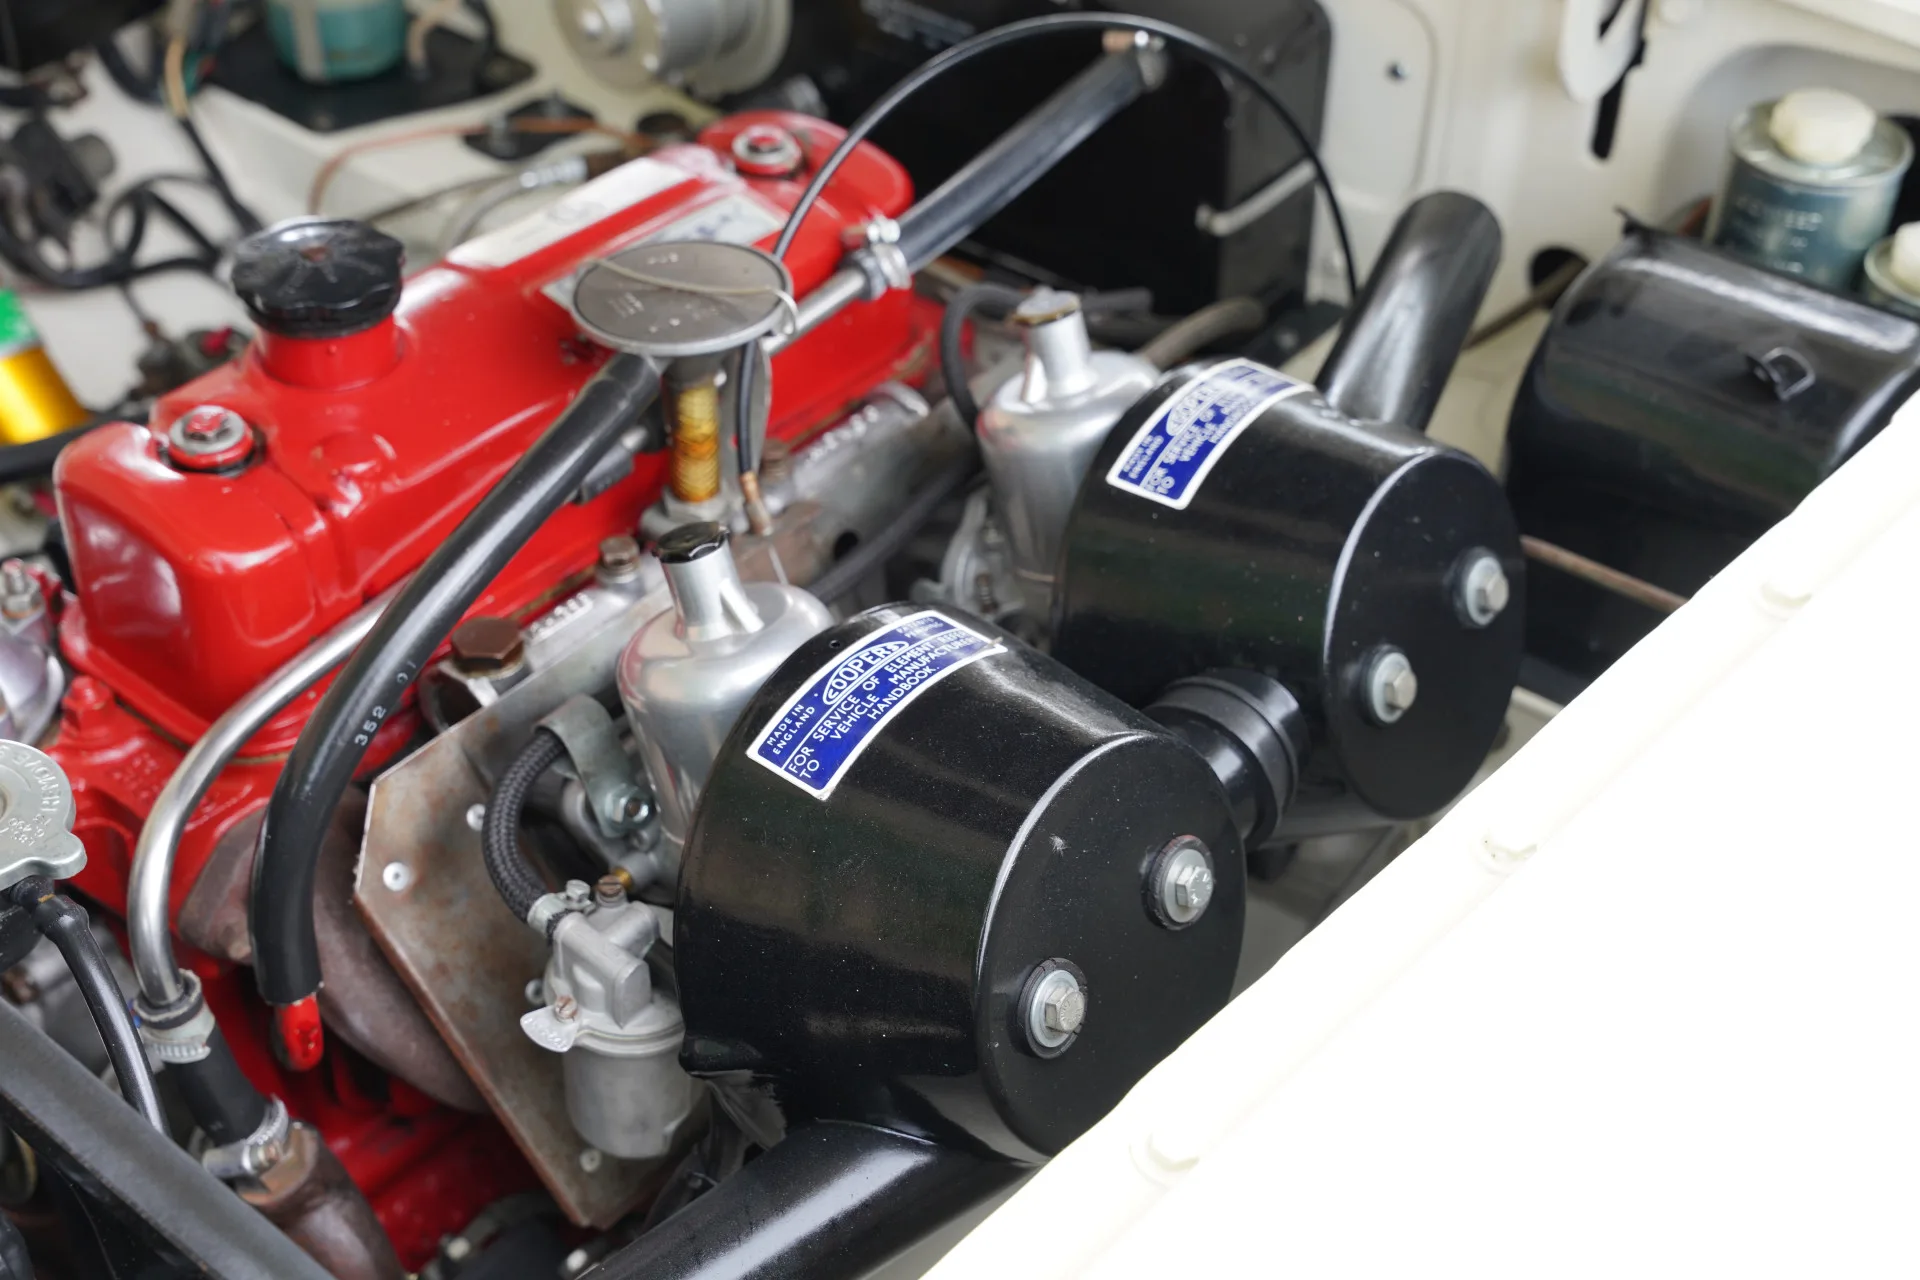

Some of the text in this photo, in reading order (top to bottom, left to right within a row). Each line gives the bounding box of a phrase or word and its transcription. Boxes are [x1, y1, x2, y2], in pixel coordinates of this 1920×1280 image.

[1156, 476, 1175, 495] TO
[828, 644, 900, 700] COOPERS
[866, 665, 940, 720] HANDBOOK.
[354, 706, 387, 746] 352
[766, 704, 804, 746] MADE IN
[772, 706, 815, 755] ENGLAND
[788, 746, 815, 773] FOR
[812, 694, 861, 742] SERVICE
[862, 675, 881, 691] OF
[884, 641, 935, 673] ELEMENT
[799, 759, 820, 779] TO
[829, 693, 880, 740] VEHICLE
